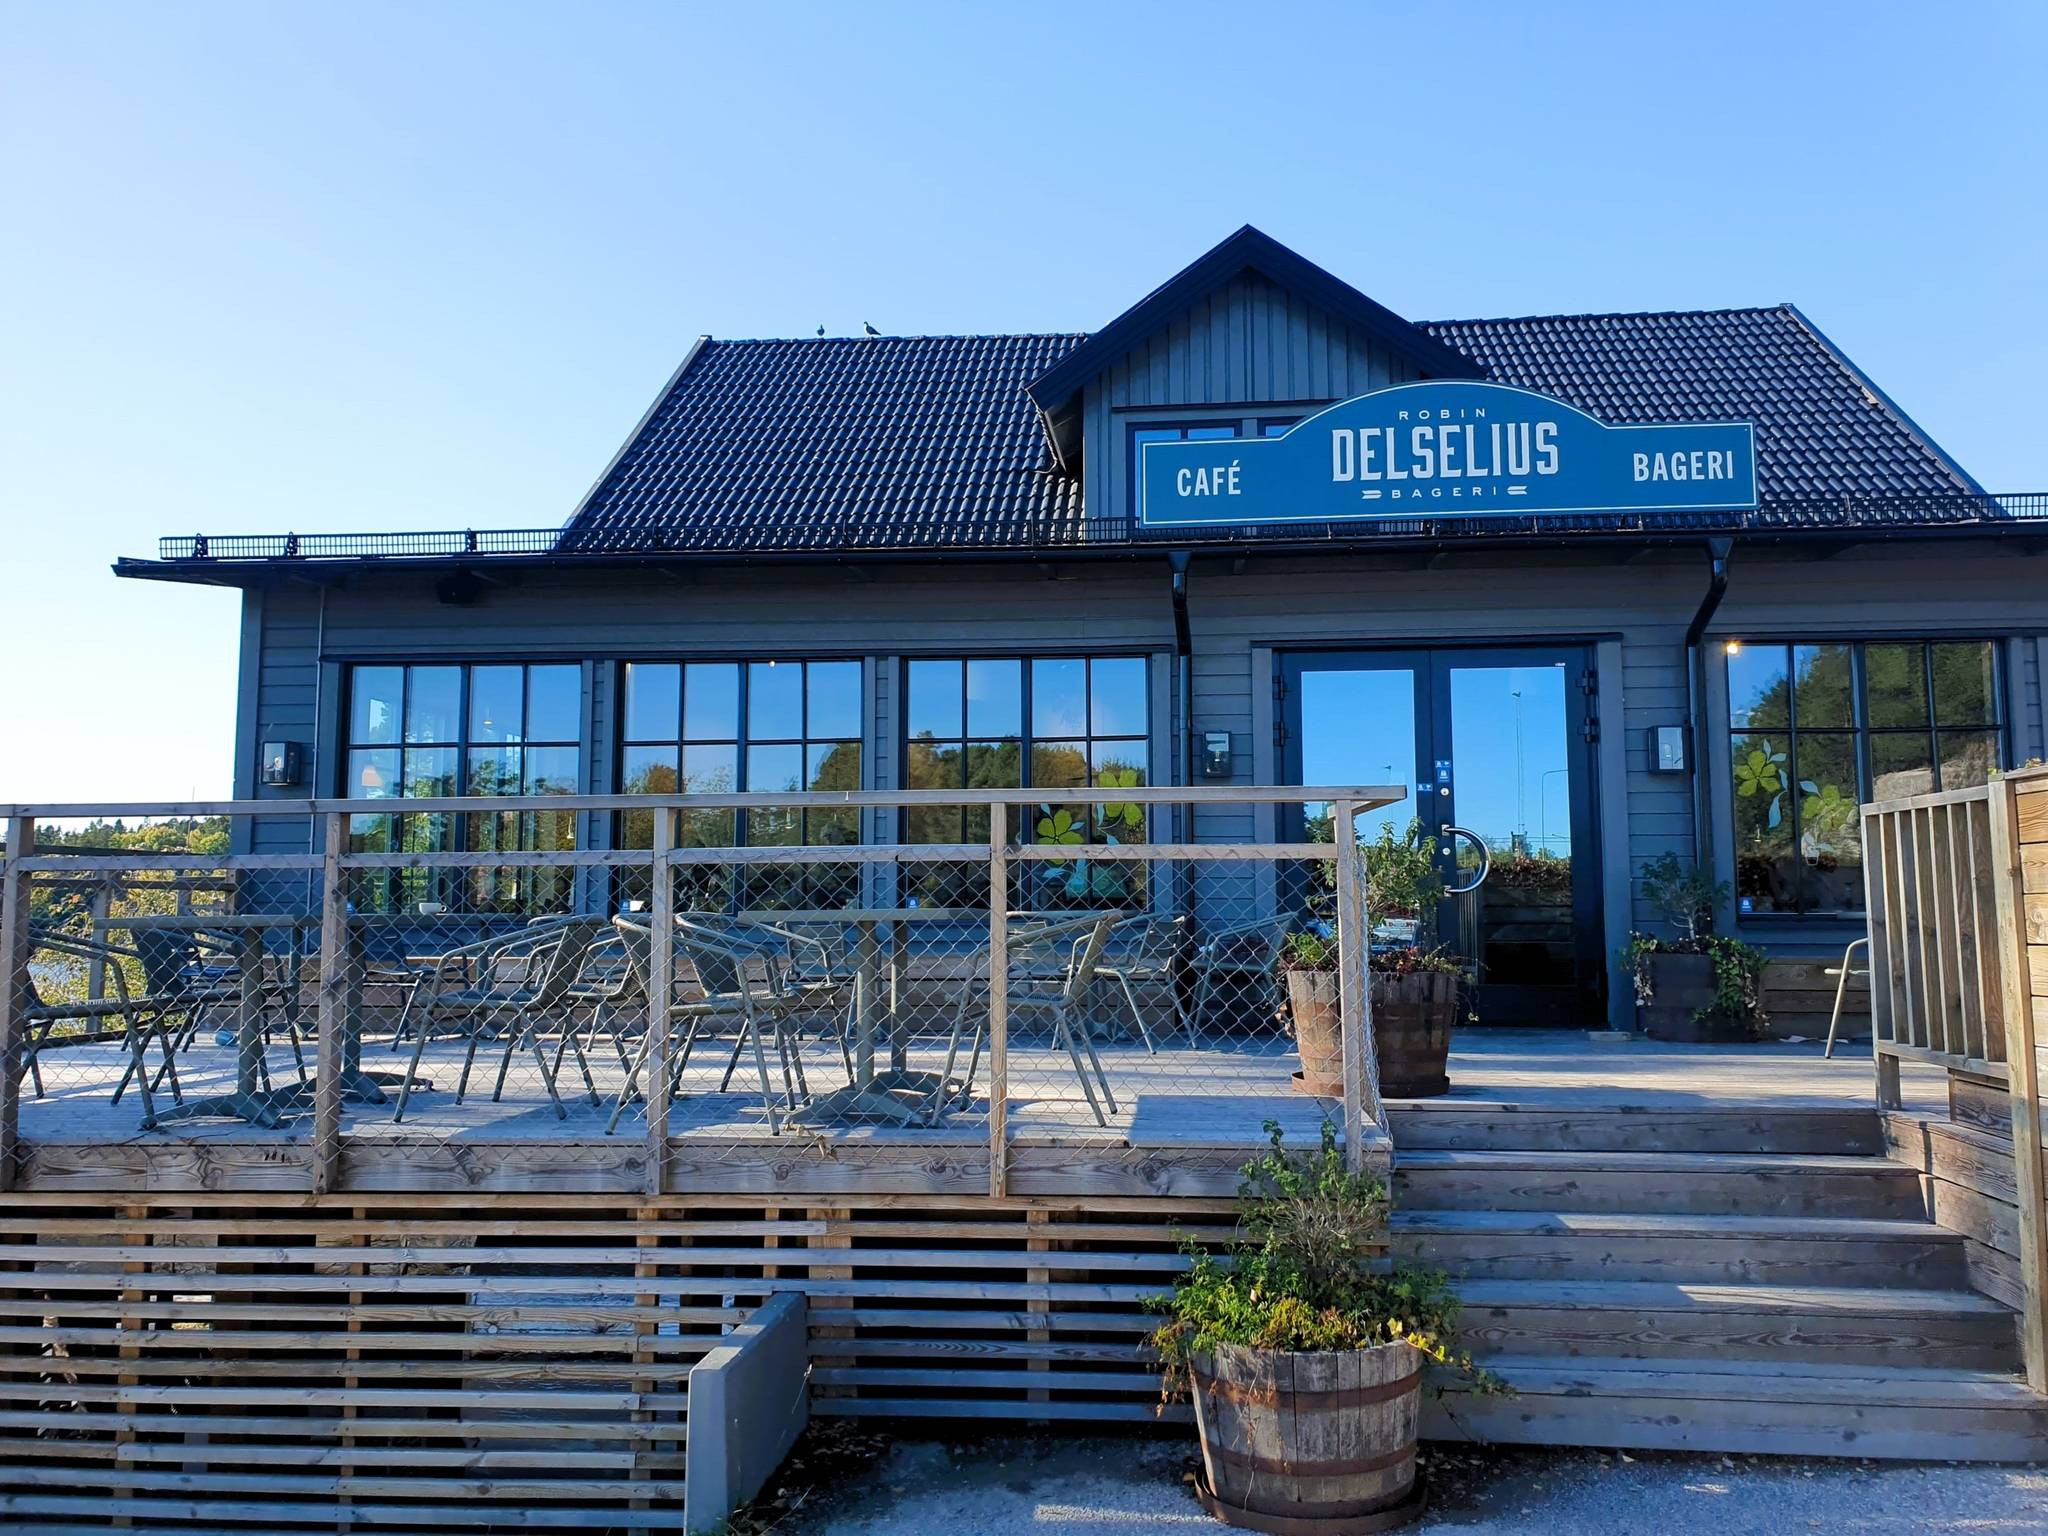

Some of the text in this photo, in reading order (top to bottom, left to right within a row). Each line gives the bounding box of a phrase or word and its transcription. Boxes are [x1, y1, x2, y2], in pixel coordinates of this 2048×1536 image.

[1399, 408, 1485, 421] ROBIN
[1332, 422, 1559, 482] DELSELIUS
[1633, 451, 1734, 482] BAGERI
[1177, 460, 1241, 497] CAFÉ
[1391, 486, 1497, 499] BAGERI
